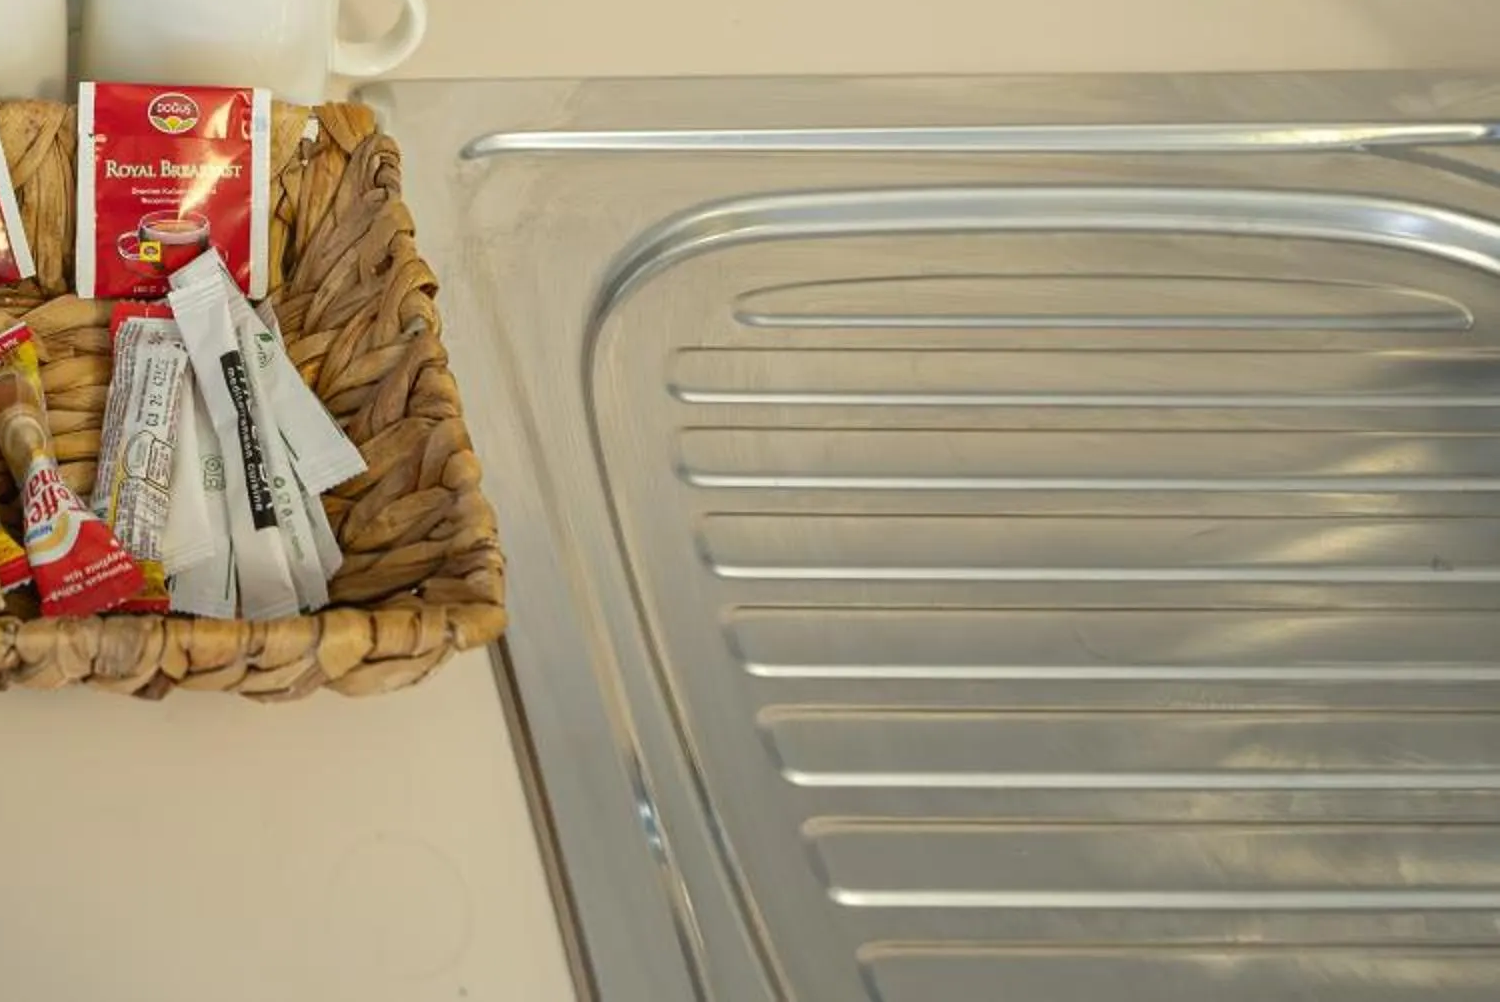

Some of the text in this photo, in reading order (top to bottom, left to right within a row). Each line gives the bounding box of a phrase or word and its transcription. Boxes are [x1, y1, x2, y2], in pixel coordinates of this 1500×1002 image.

[106, 159, 242, 179] ROYAL BREAST
[248, 463, 263, 511] cuisine
